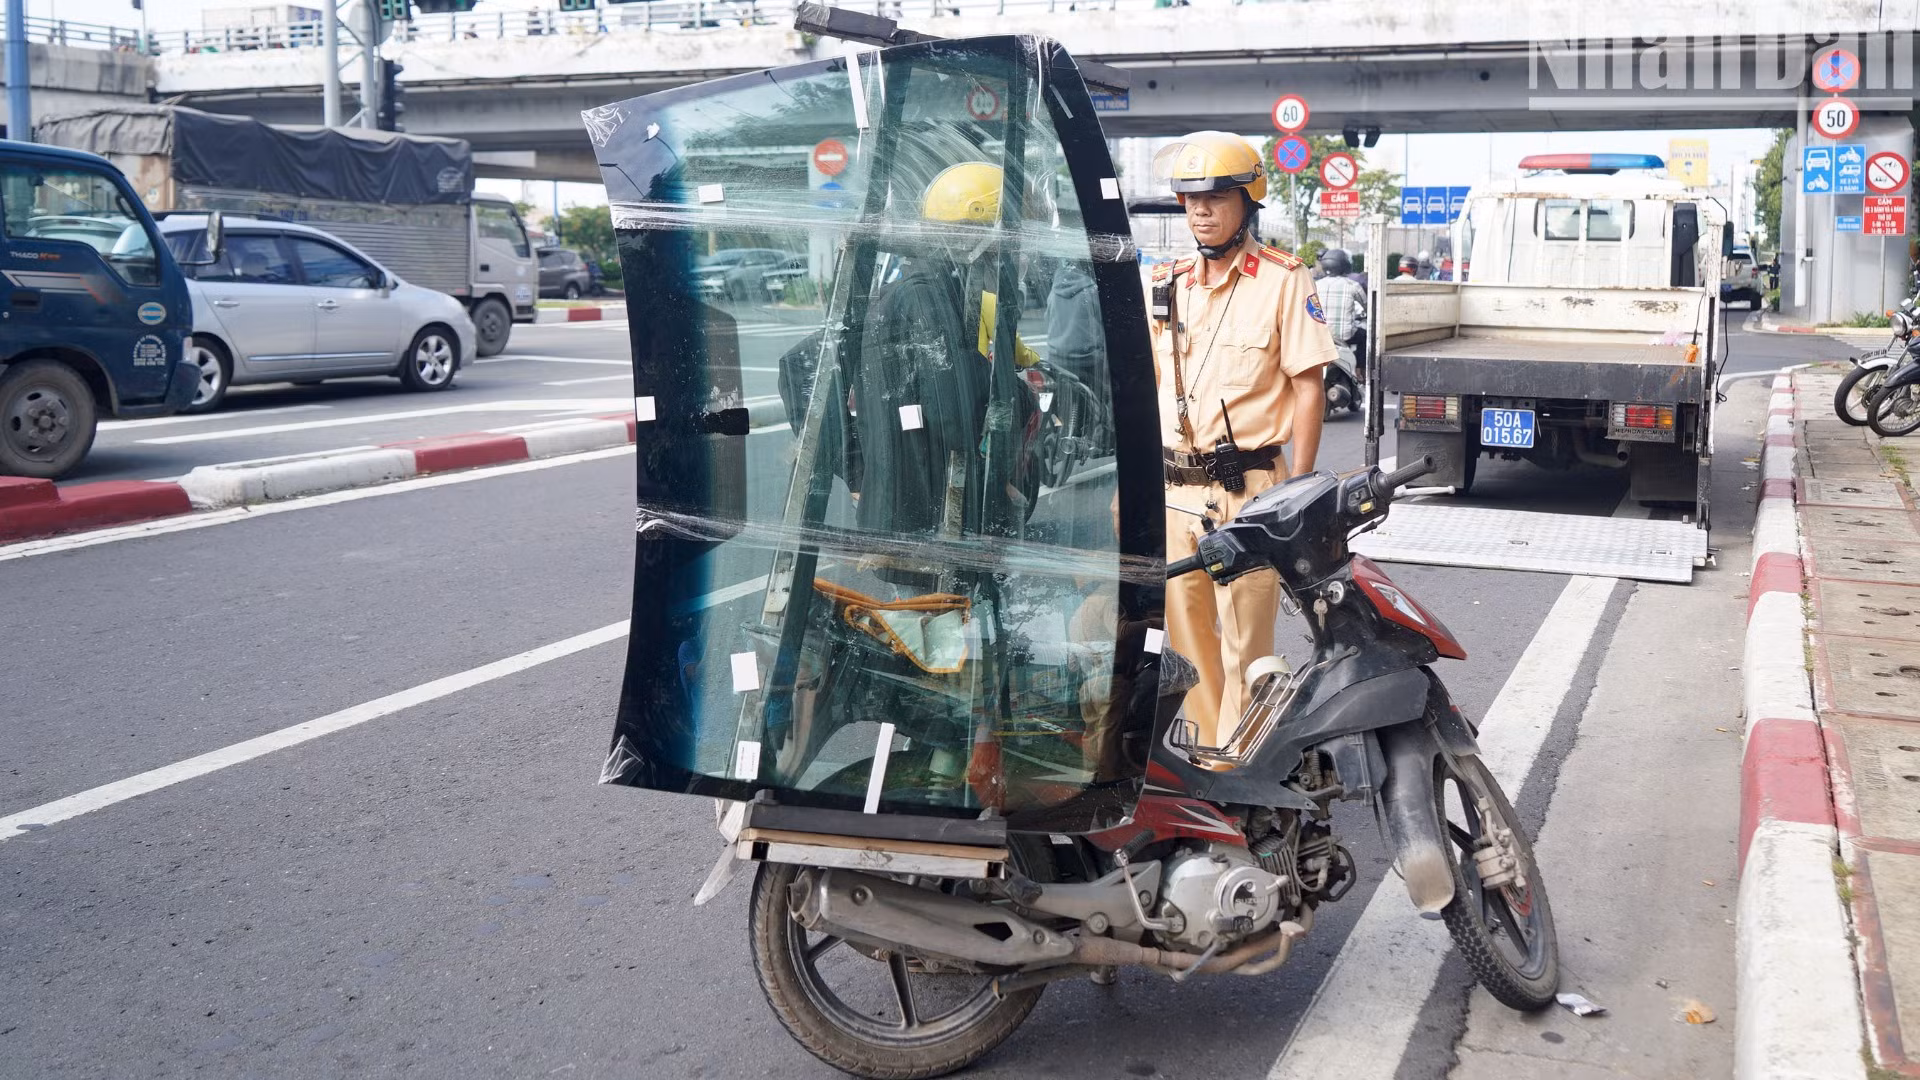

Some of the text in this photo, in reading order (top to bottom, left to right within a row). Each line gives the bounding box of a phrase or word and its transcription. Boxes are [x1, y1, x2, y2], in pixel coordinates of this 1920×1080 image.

[1283, 105, 1298, 122] 60
[1827, 109, 1846, 127] 50
[1494, 411, 1522, 428] 50A
[1483, 426, 1532, 445] 015.67
